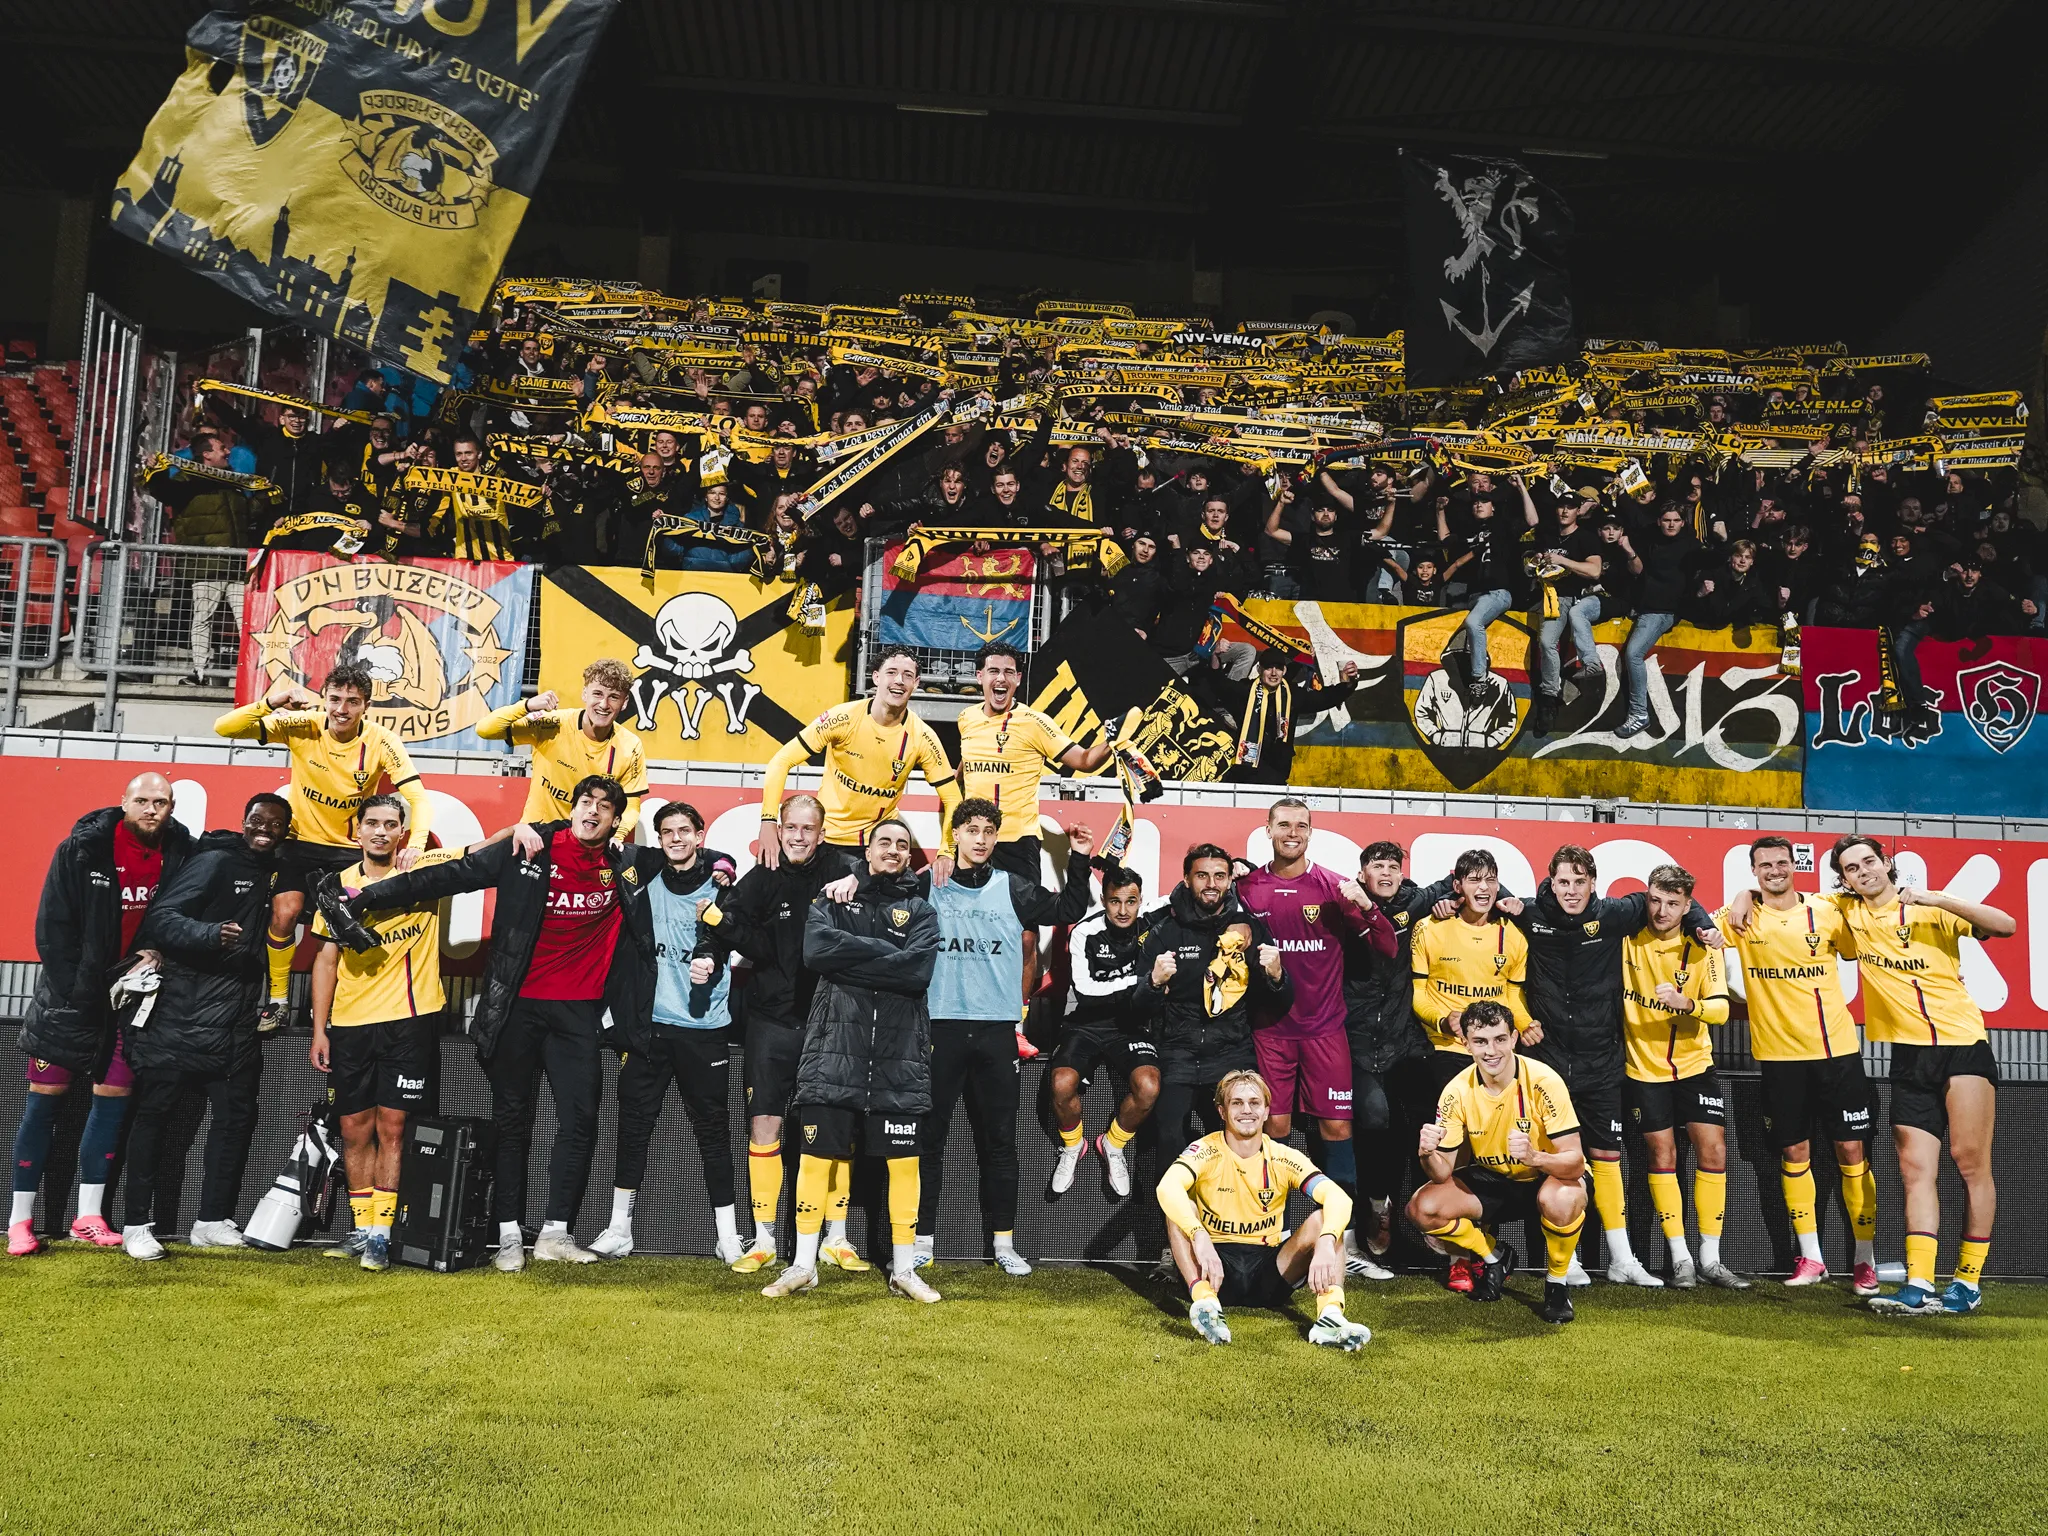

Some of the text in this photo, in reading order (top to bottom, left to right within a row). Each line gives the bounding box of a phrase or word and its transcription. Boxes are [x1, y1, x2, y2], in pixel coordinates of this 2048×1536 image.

[642, 295, 688, 307] SUPPORTER
[904, 293, 971, 304] VVV-VENL
[1173, 333, 1262, 347] VVV-VENLO
[843, 353, 882, 364] SAMEN
[884, 359, 923, 374] ACHTER
[952, 353, 971, 362] Venlo
[520, 377, 549, 389] SAME
[1169, 374, 1222, 383] SUPPORTER
[1099, 385, 1159, 396] ACHTER
[1702, 385, 1753, 394] VENLO
[1158, 401, 1181, 413] Venlo
[1203, 405, 1222, 414] stad
[1257, 398, 1279, 406] CLUB
[1625, 398, 1643, 408] AME
[611, 412, 693, 426] SAMEN ACHTER
[1122, 414, 1150, 424] VENLO
[1178, 421, 1205, 432] SINDS
[1265, 428, 1287, 437] stad
[1565, 433, 1598, 444] WANT
[1637, 437, 1664, 448] ZIEN
[1954, 440, 1968, 450] Zoë
[1971, 439, 2000, 449] besteit
[1160, 438, 1200, 450] SAMEN
[1200, 441, 1245, 457] ACHTER
[820, 479, 839, 498] Zoë
[839, 456, 872, 484] besteit
[873, 447, 886, 461] d'r
[889, 424, 915, 447] maar
[917, 411, 932, 427] ein
[1287, 450, 1300, 459] d'r
[1952, 455, 2011, 465] d'r maar ein
[417, 468, 540, 499] VVV-VENLO
[427, 482, 463, 492] YELLOW
[468, 488, 497, 499] BLACK
[503, 495, 528, 505] ARMY
[294, 567, 485, 611] D'N BUIZERD
[1245, 622, 1290, 653] FANATICS
[265, 641, 290, 650] SINCE
[477, 655, 499, 665] 2022
[816, 713, 850, 735] ProToGa
[1099, 944, 1110, 954] 34
[1749, 966, 1827, 979] THIELMANN.
[1843, 1107, 1869, 1123] haa!
[884, 1119, 917, 1135] haa!
[420, 1146, 436, 1155] PELI
